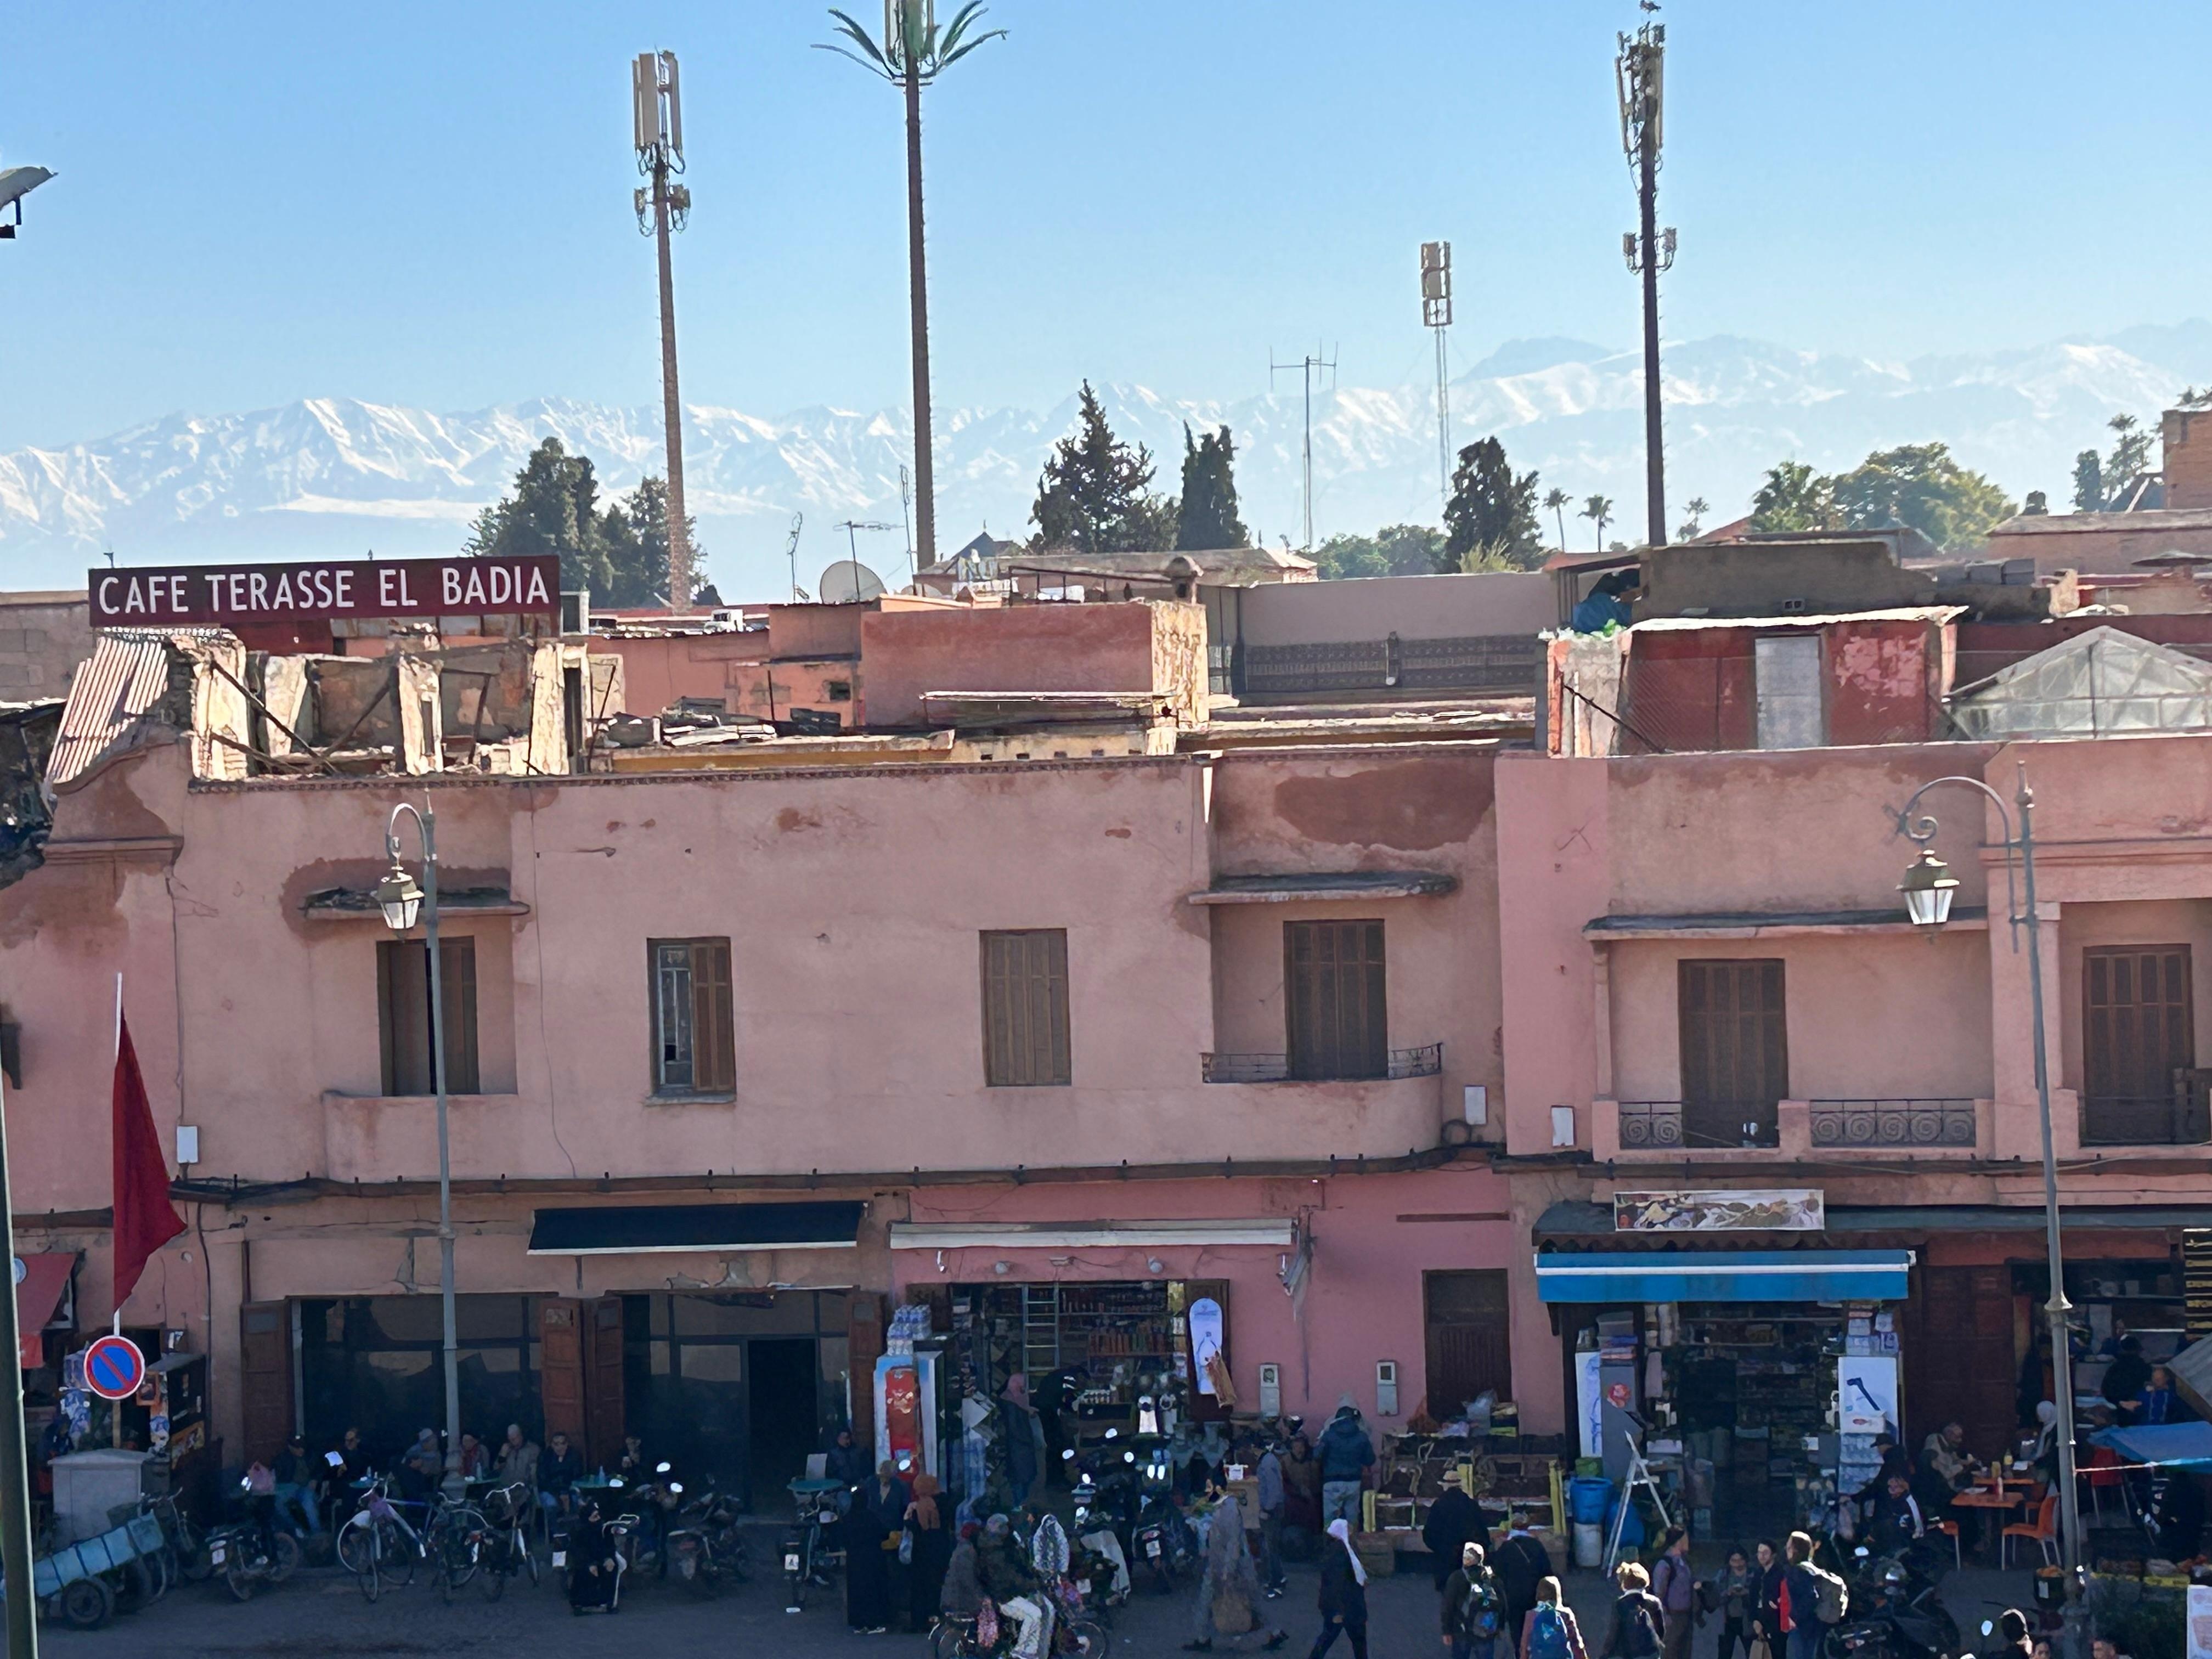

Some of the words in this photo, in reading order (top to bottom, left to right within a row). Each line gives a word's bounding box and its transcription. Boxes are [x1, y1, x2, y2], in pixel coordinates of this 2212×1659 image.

[98, 575, 189, 614] CAFE
[204, 570, 354, 612] TERASSE
[379, 568, 419, 607] EL
[441, 566, 550, 605] BADIA
